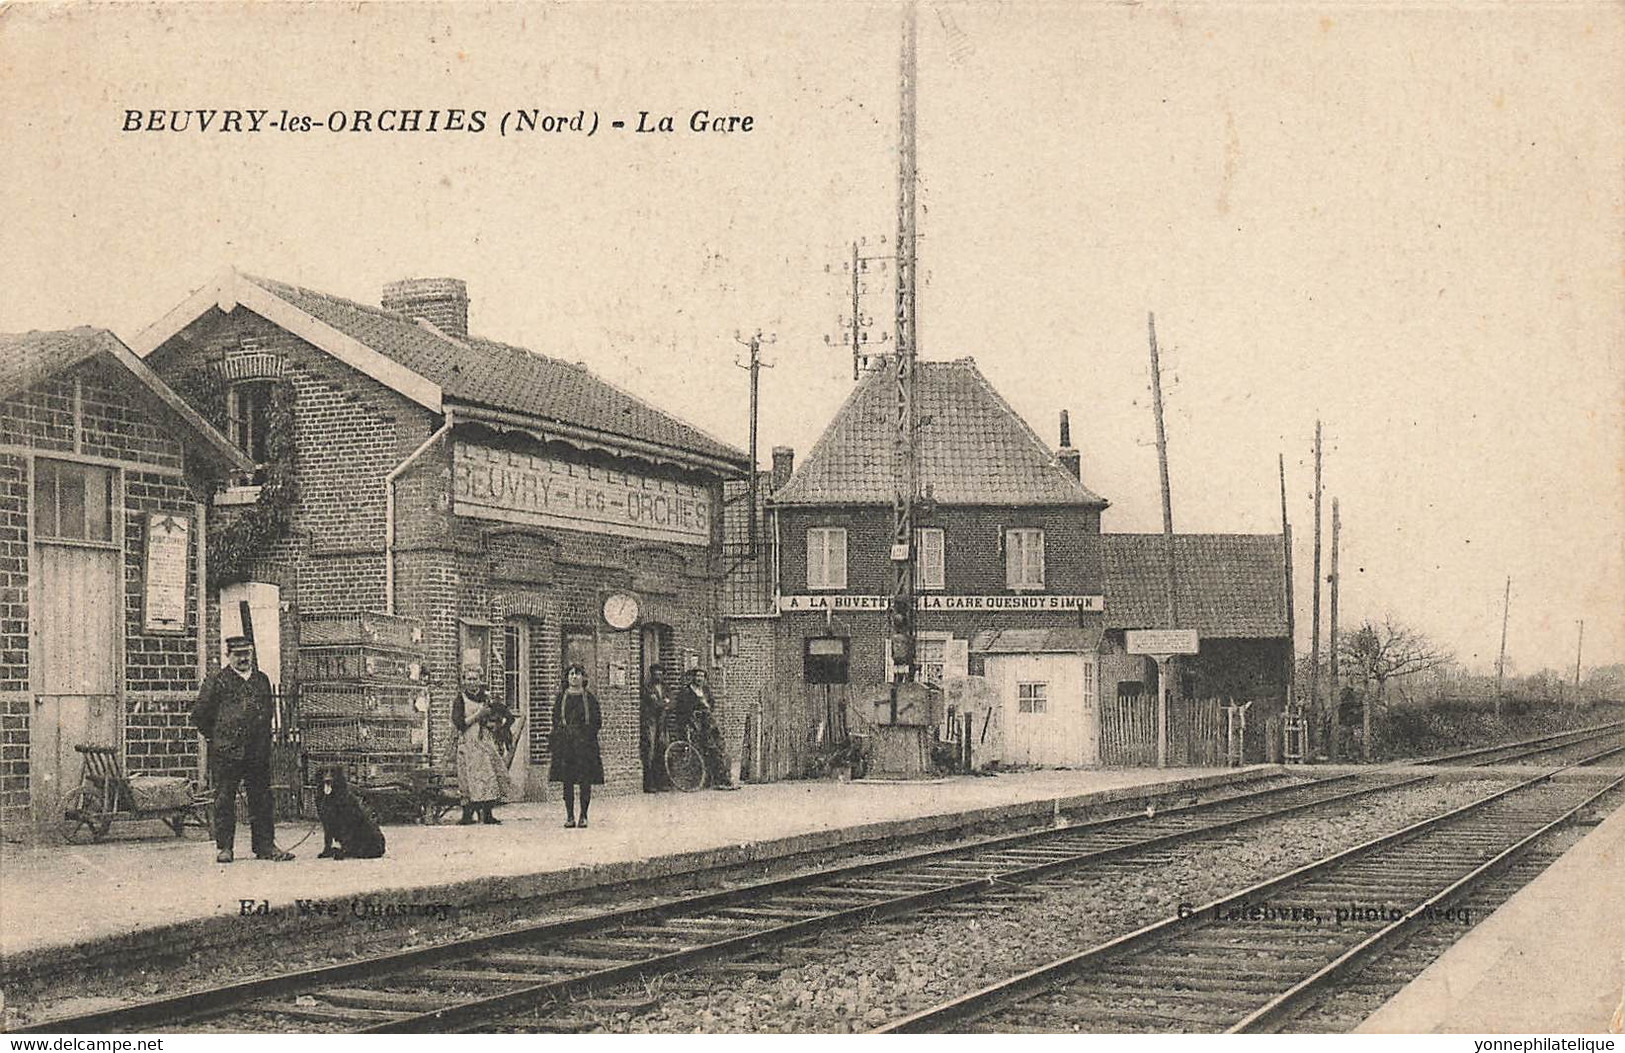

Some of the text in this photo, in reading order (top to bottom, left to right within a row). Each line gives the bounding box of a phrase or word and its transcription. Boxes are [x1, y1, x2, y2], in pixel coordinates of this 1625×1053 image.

[790, 597, 799, 608] A
[810, 597, 828, 608] LA
[924, 597, 941, 608] LA
[946, 597, 982, 608] GARE
[986, 597, 1046, 609] QUESNOY
[1050, 597, 1092, 609] SIMON
